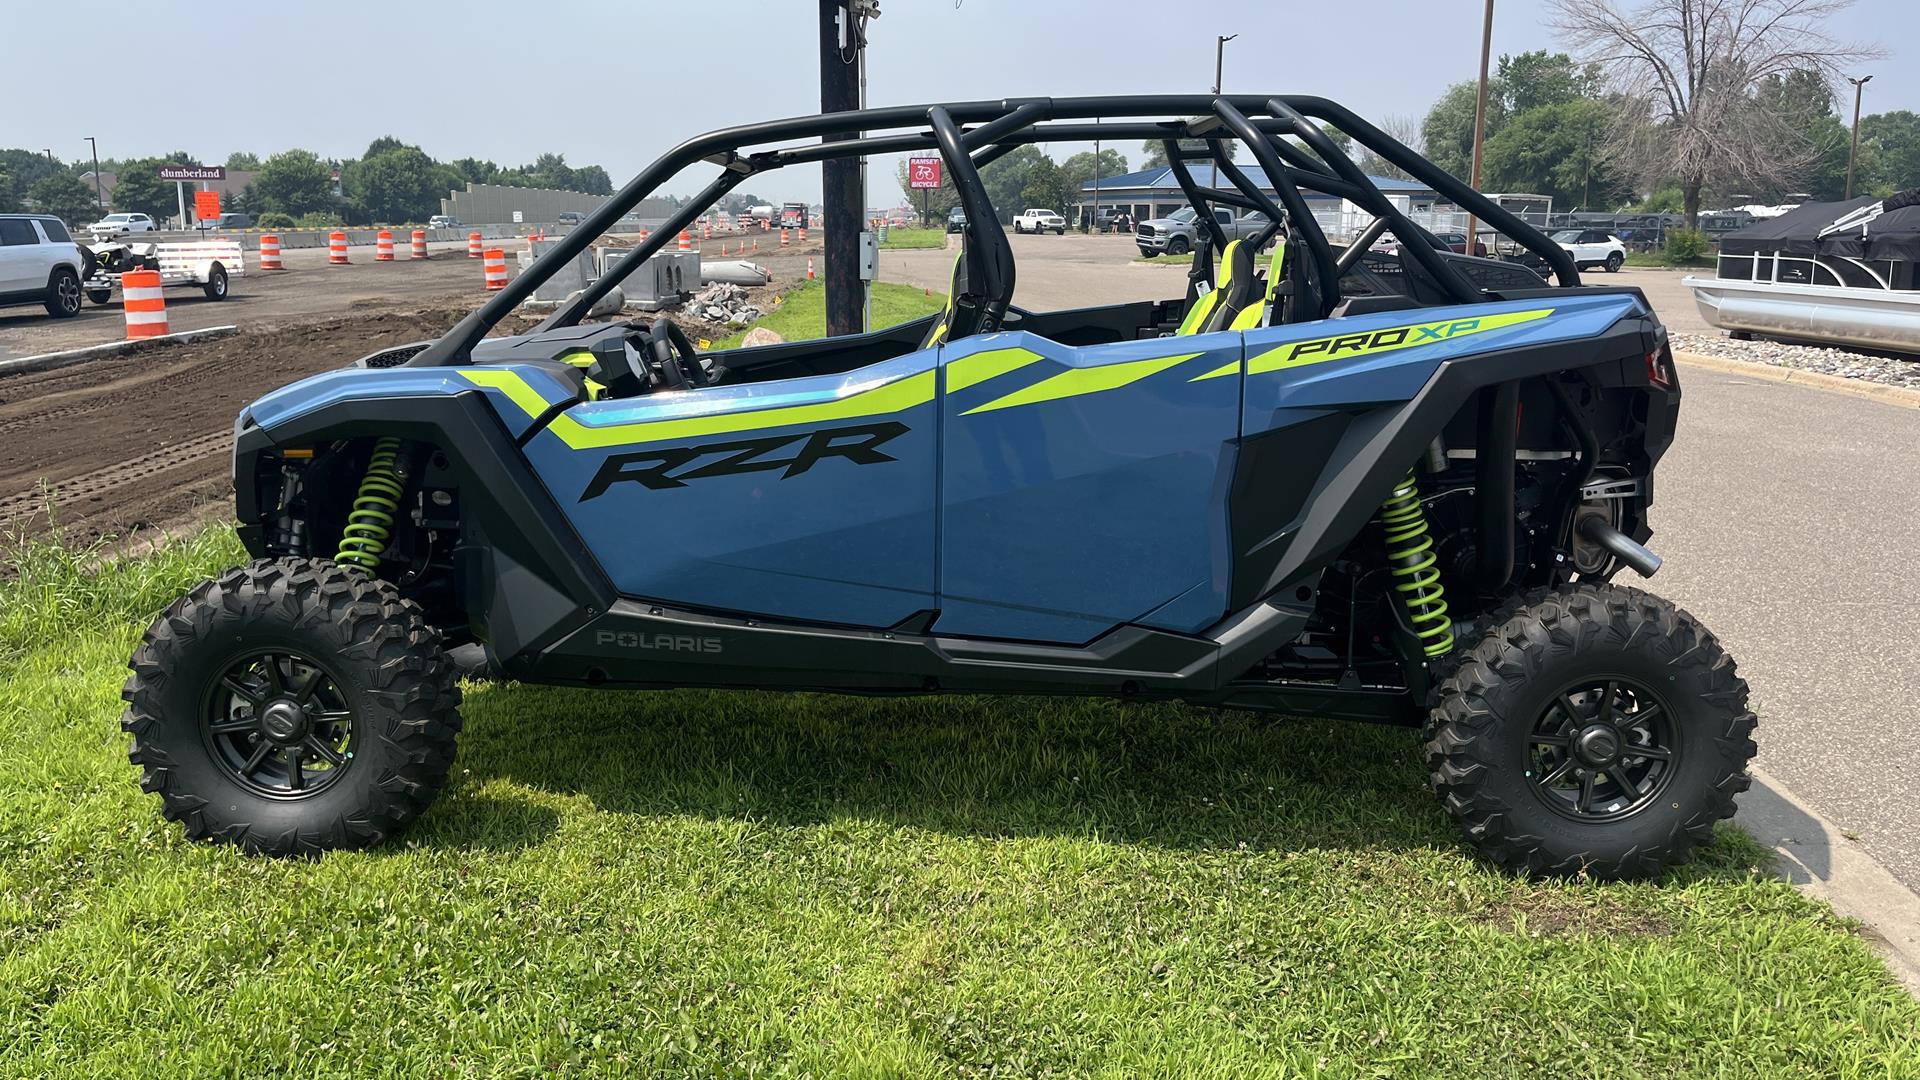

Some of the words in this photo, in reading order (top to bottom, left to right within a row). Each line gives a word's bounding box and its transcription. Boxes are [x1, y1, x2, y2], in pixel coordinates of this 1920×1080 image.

[160, 168, 220, 178] slumberland
[577, 421, 912, 504] RZR
[596, 630, 723, 653] POLARIS
